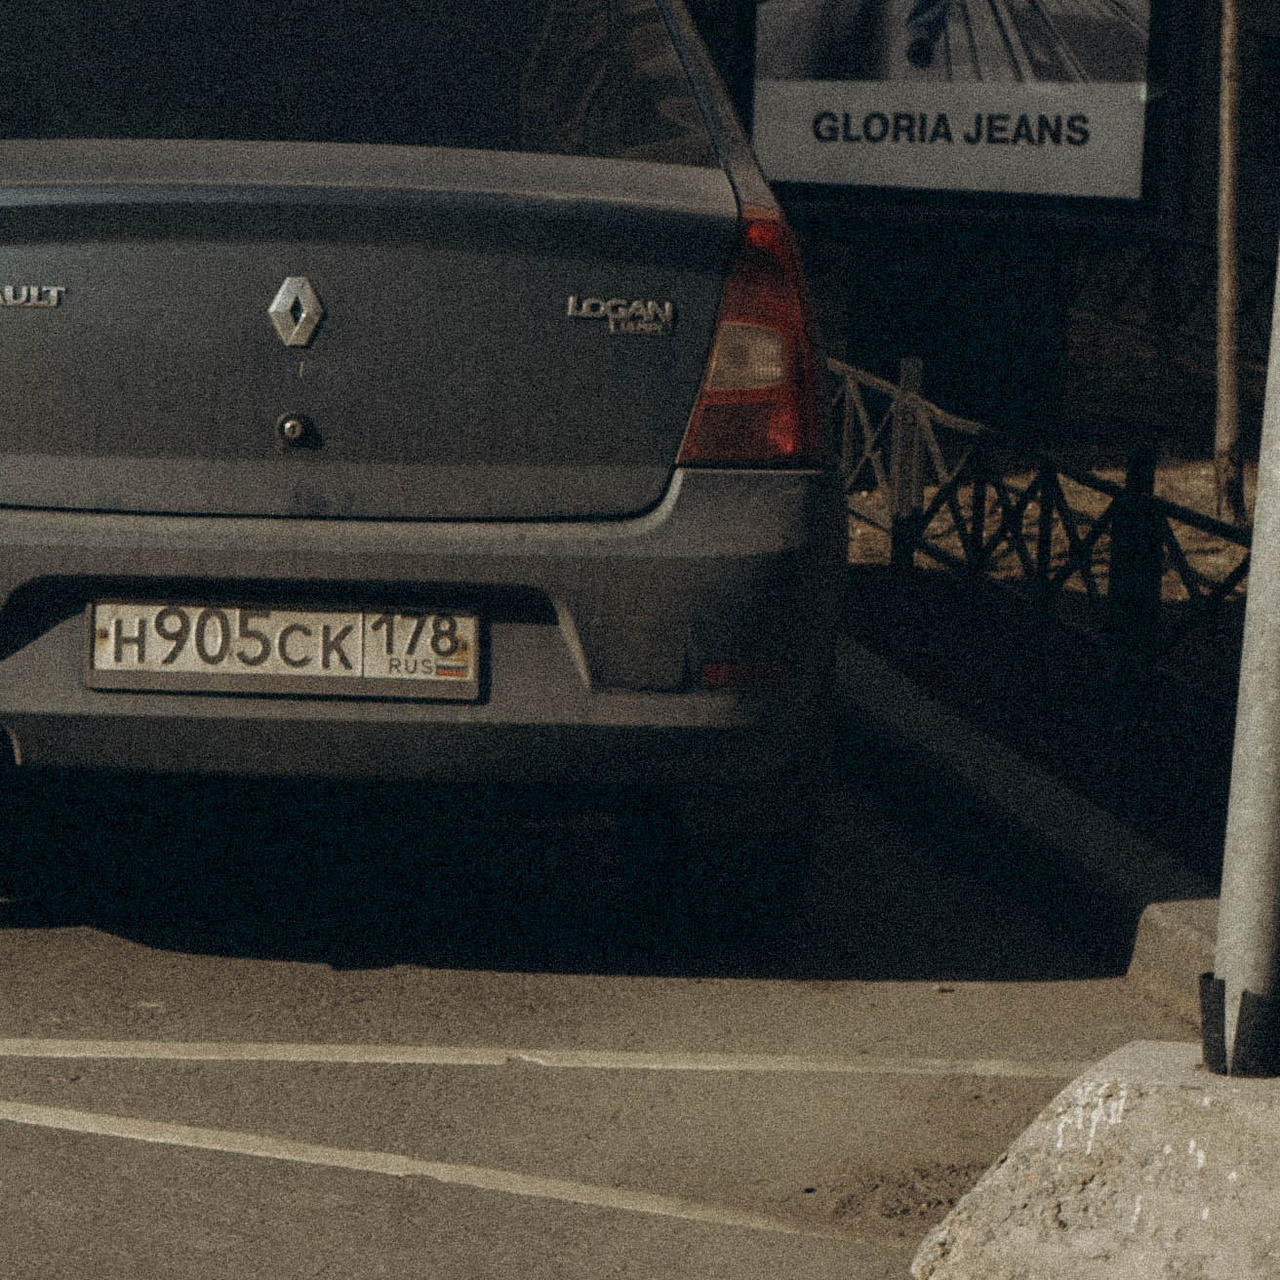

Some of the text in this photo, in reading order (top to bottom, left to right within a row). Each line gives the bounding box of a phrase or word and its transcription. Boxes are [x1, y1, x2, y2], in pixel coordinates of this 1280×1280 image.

[812, 111, 1091, 147] GLORIA JEANS
[567, 293, 675, 323] LOGAN
[371, 611, 459, 657] 178
[388, 658, 435, 675] RUS
